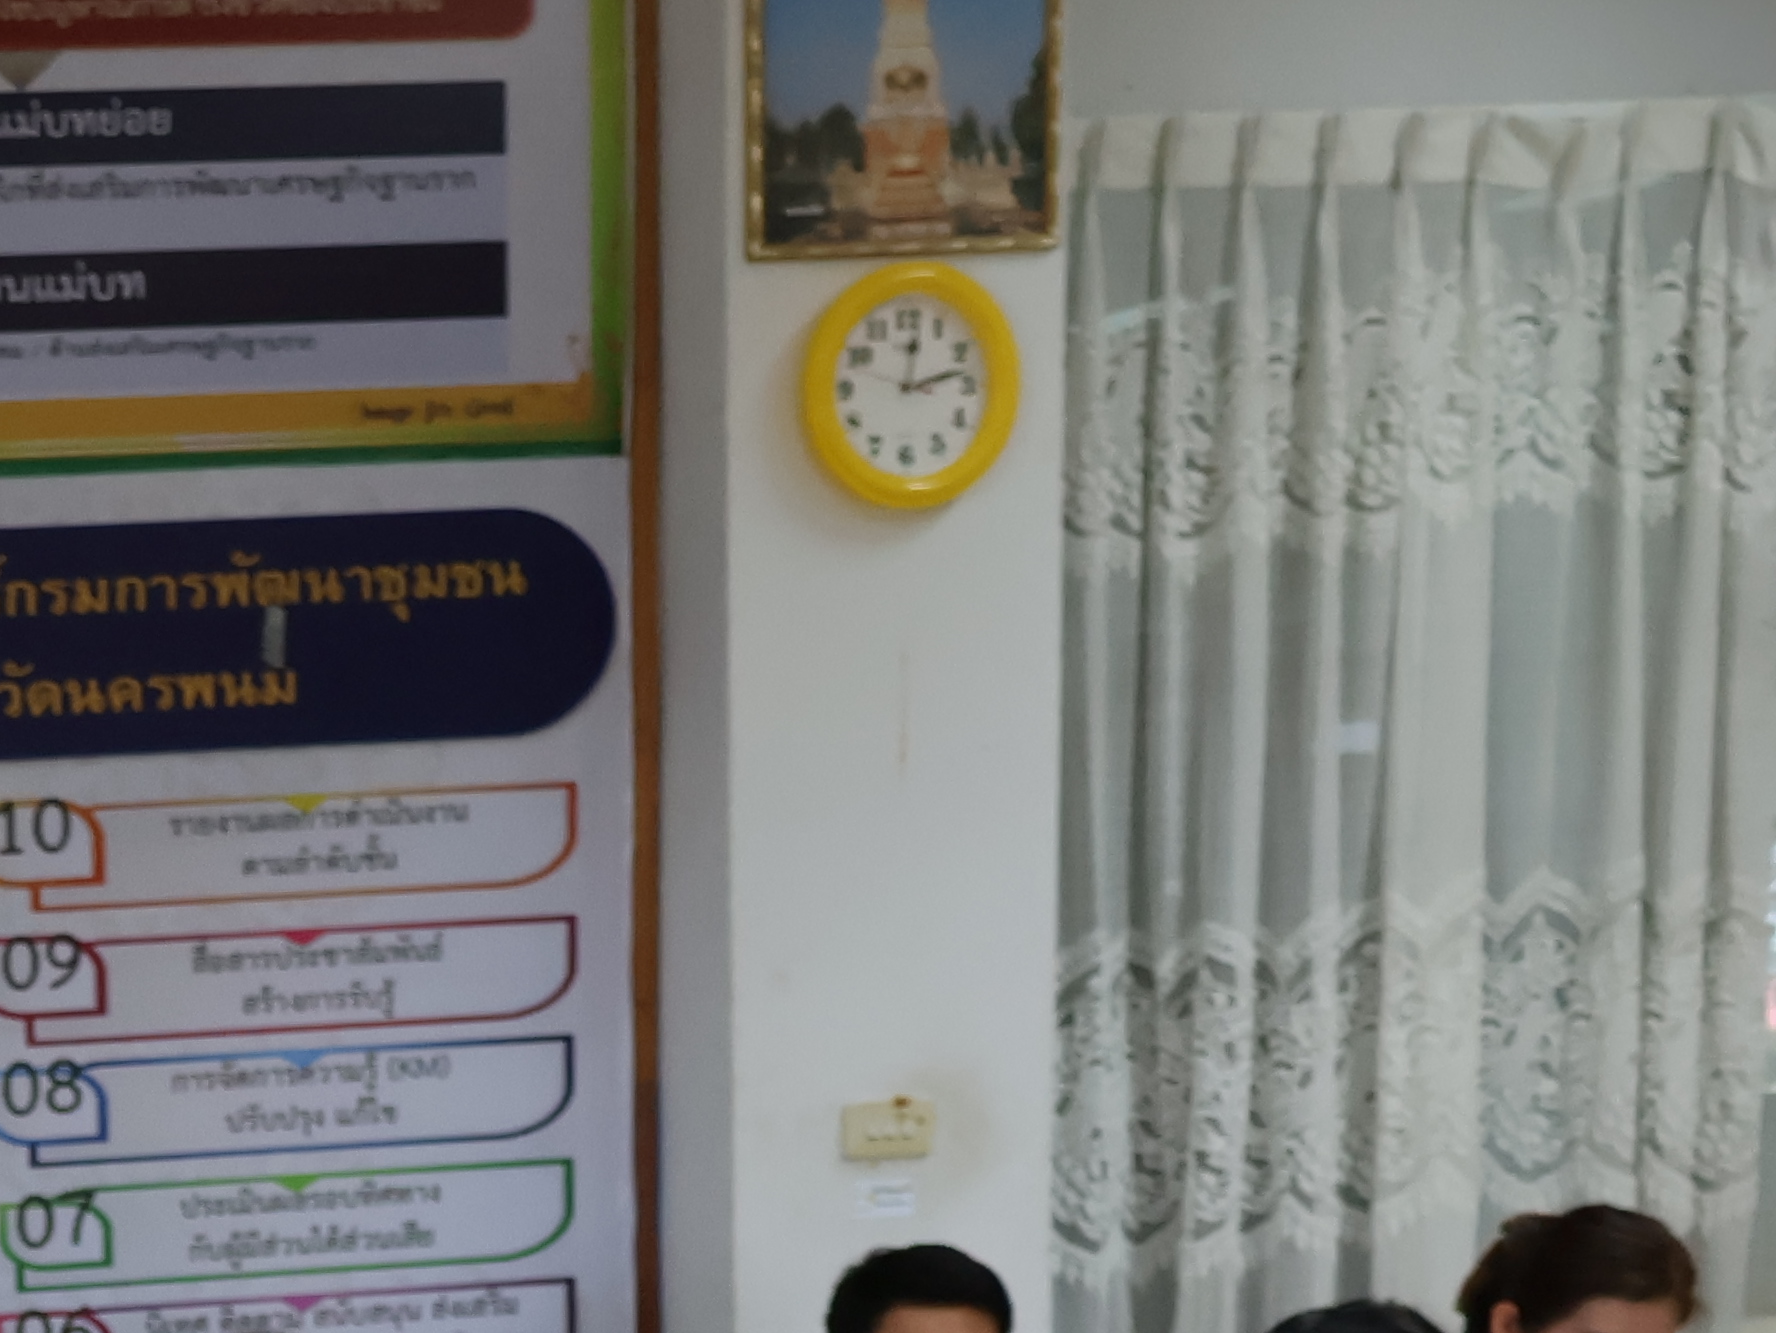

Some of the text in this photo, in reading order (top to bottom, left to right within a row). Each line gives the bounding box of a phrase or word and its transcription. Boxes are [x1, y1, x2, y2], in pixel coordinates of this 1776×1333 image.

[1, 934, 84, 990] 09
[1, 1060, 85, 1116] 08
[16, 1190, 95, 1249] 07
